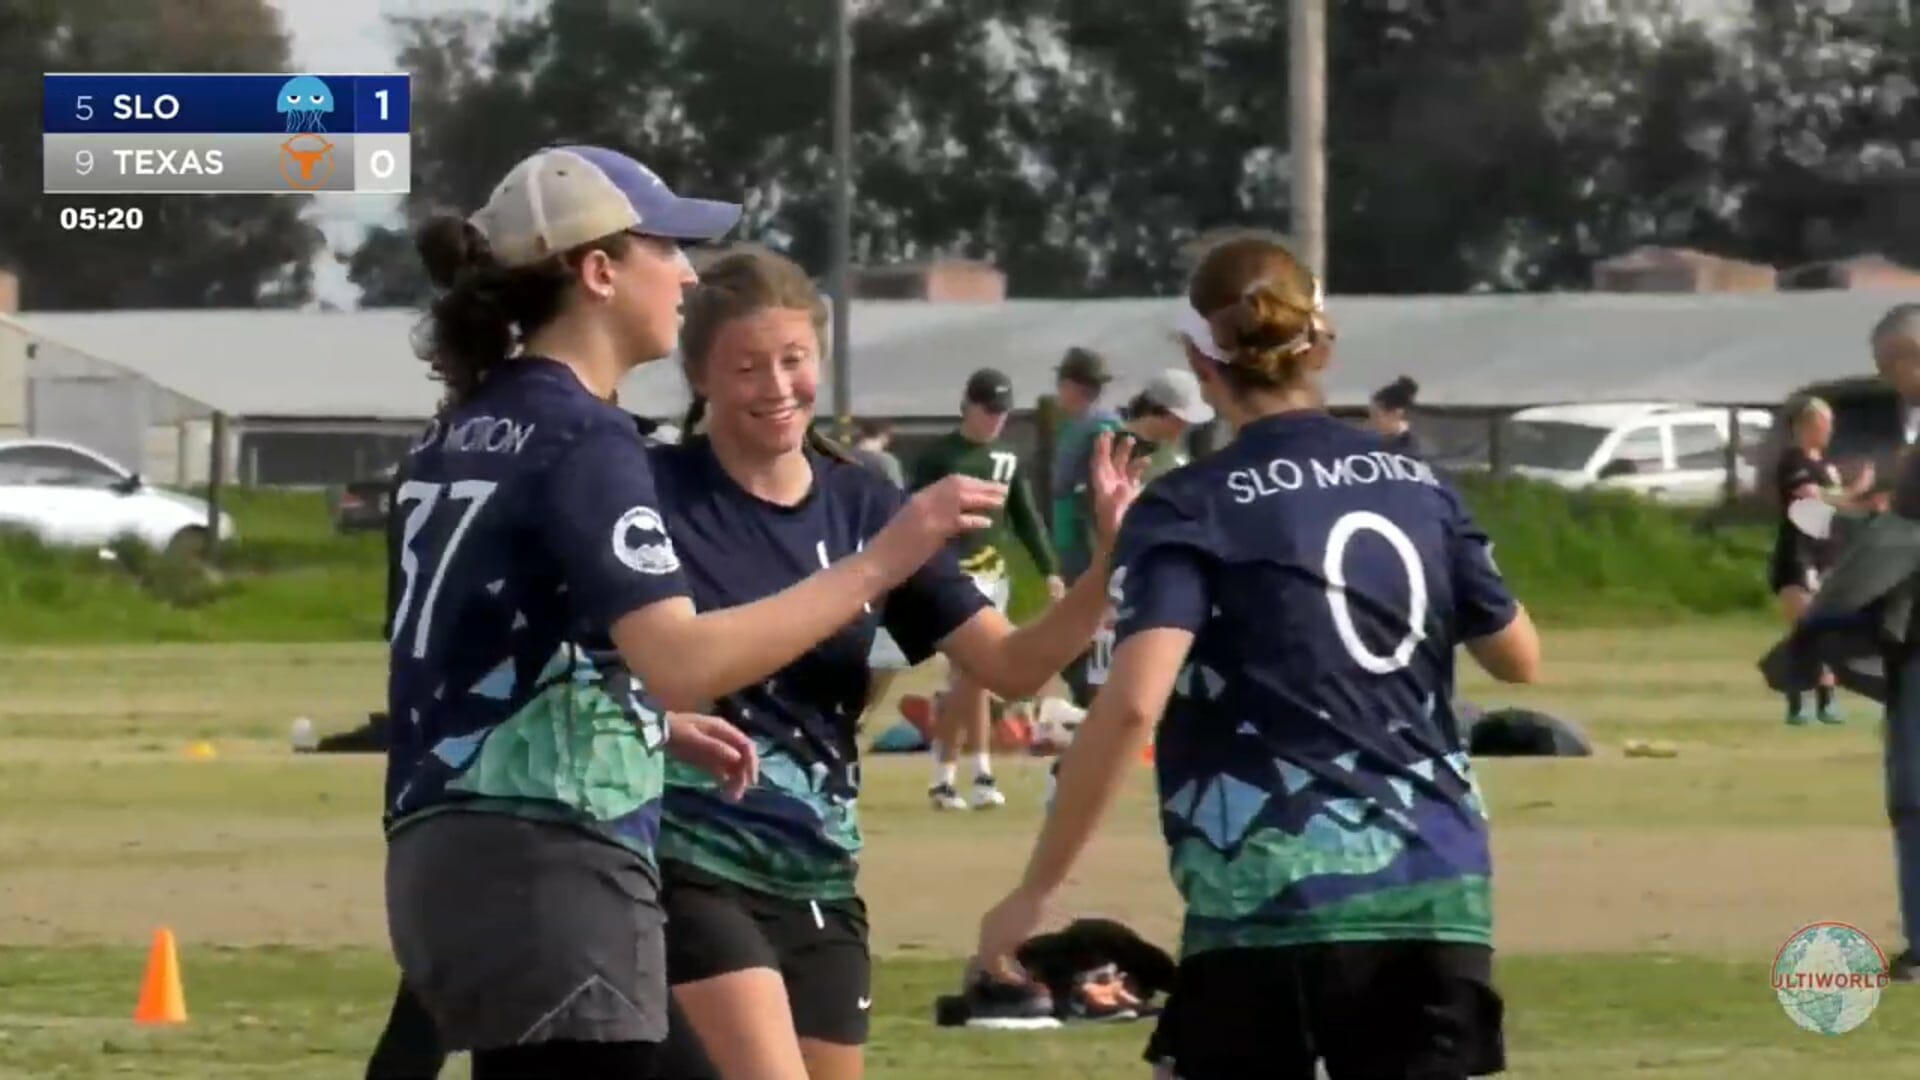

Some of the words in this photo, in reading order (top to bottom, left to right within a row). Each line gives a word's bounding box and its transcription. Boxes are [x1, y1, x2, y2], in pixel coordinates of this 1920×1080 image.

[1227, 459, 1304, 505] SLO
[1310, 450, 1439, 489] MOTION
[1323, 510, 1429, 675] 0
